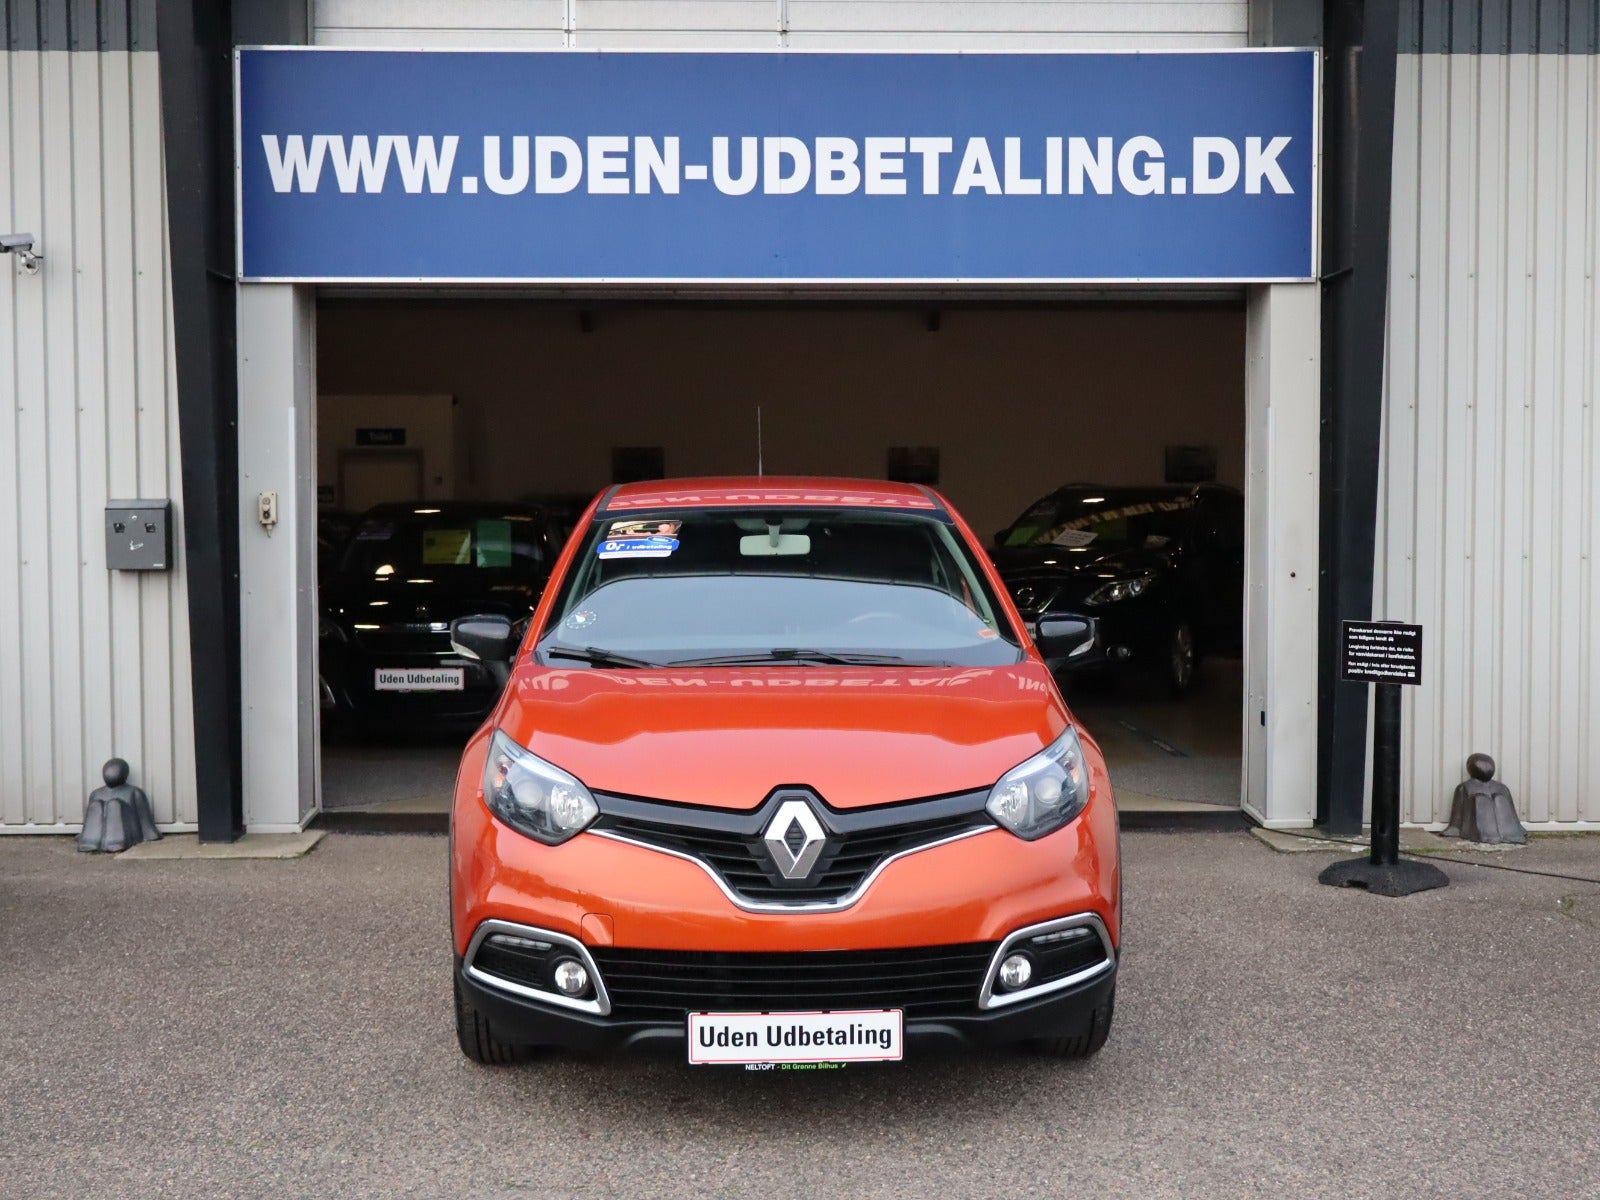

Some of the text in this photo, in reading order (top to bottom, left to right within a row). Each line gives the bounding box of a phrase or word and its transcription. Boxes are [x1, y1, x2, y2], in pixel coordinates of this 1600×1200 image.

[261, 134, 1295, 195] WWW.UDEN-UDBETALING.DK
[379, 674, 459, 685] Uden Udbetaling
[699, 1024, 892, 1049] Uden Udbetaling
[745, 1063, 776, 1071] NELTOFT
